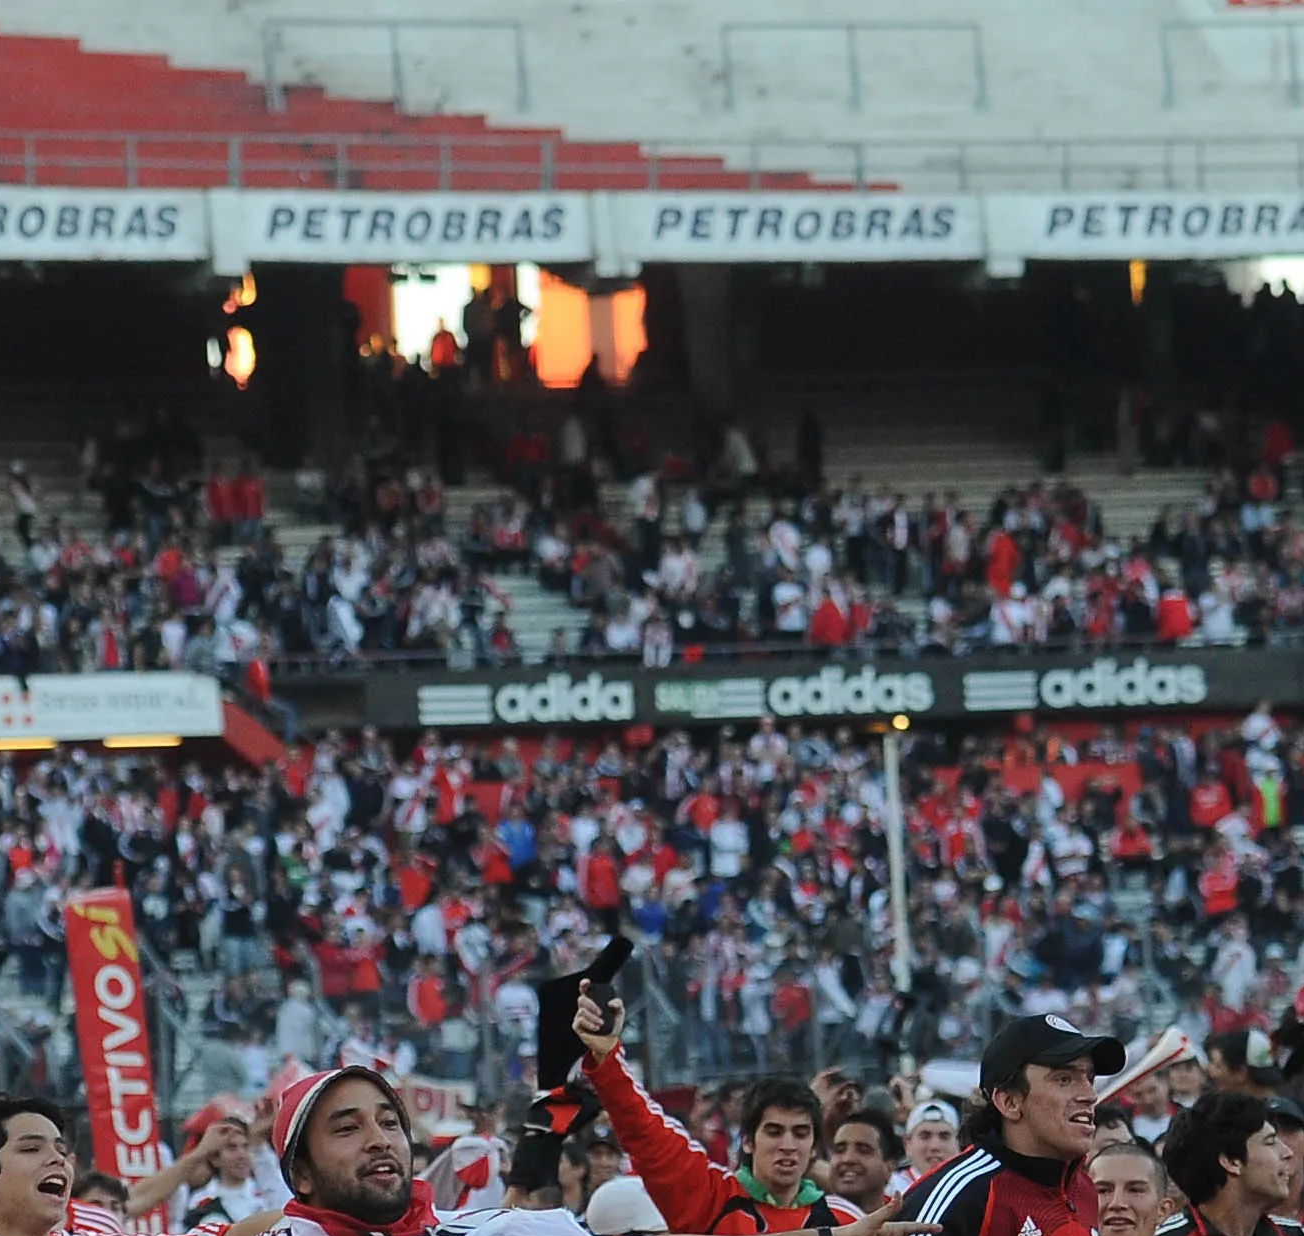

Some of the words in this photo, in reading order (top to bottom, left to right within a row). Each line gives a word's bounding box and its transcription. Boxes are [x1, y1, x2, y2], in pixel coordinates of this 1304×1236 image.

[267, 204, 565, 242] PETROBRAS
[655, 206, 955, 241] PETROBRAS
[768, 665, 934, 718] adidas
[1040, 658, 1207, 709] adidas
[94, 964, 165, 1235] EECTIVO
